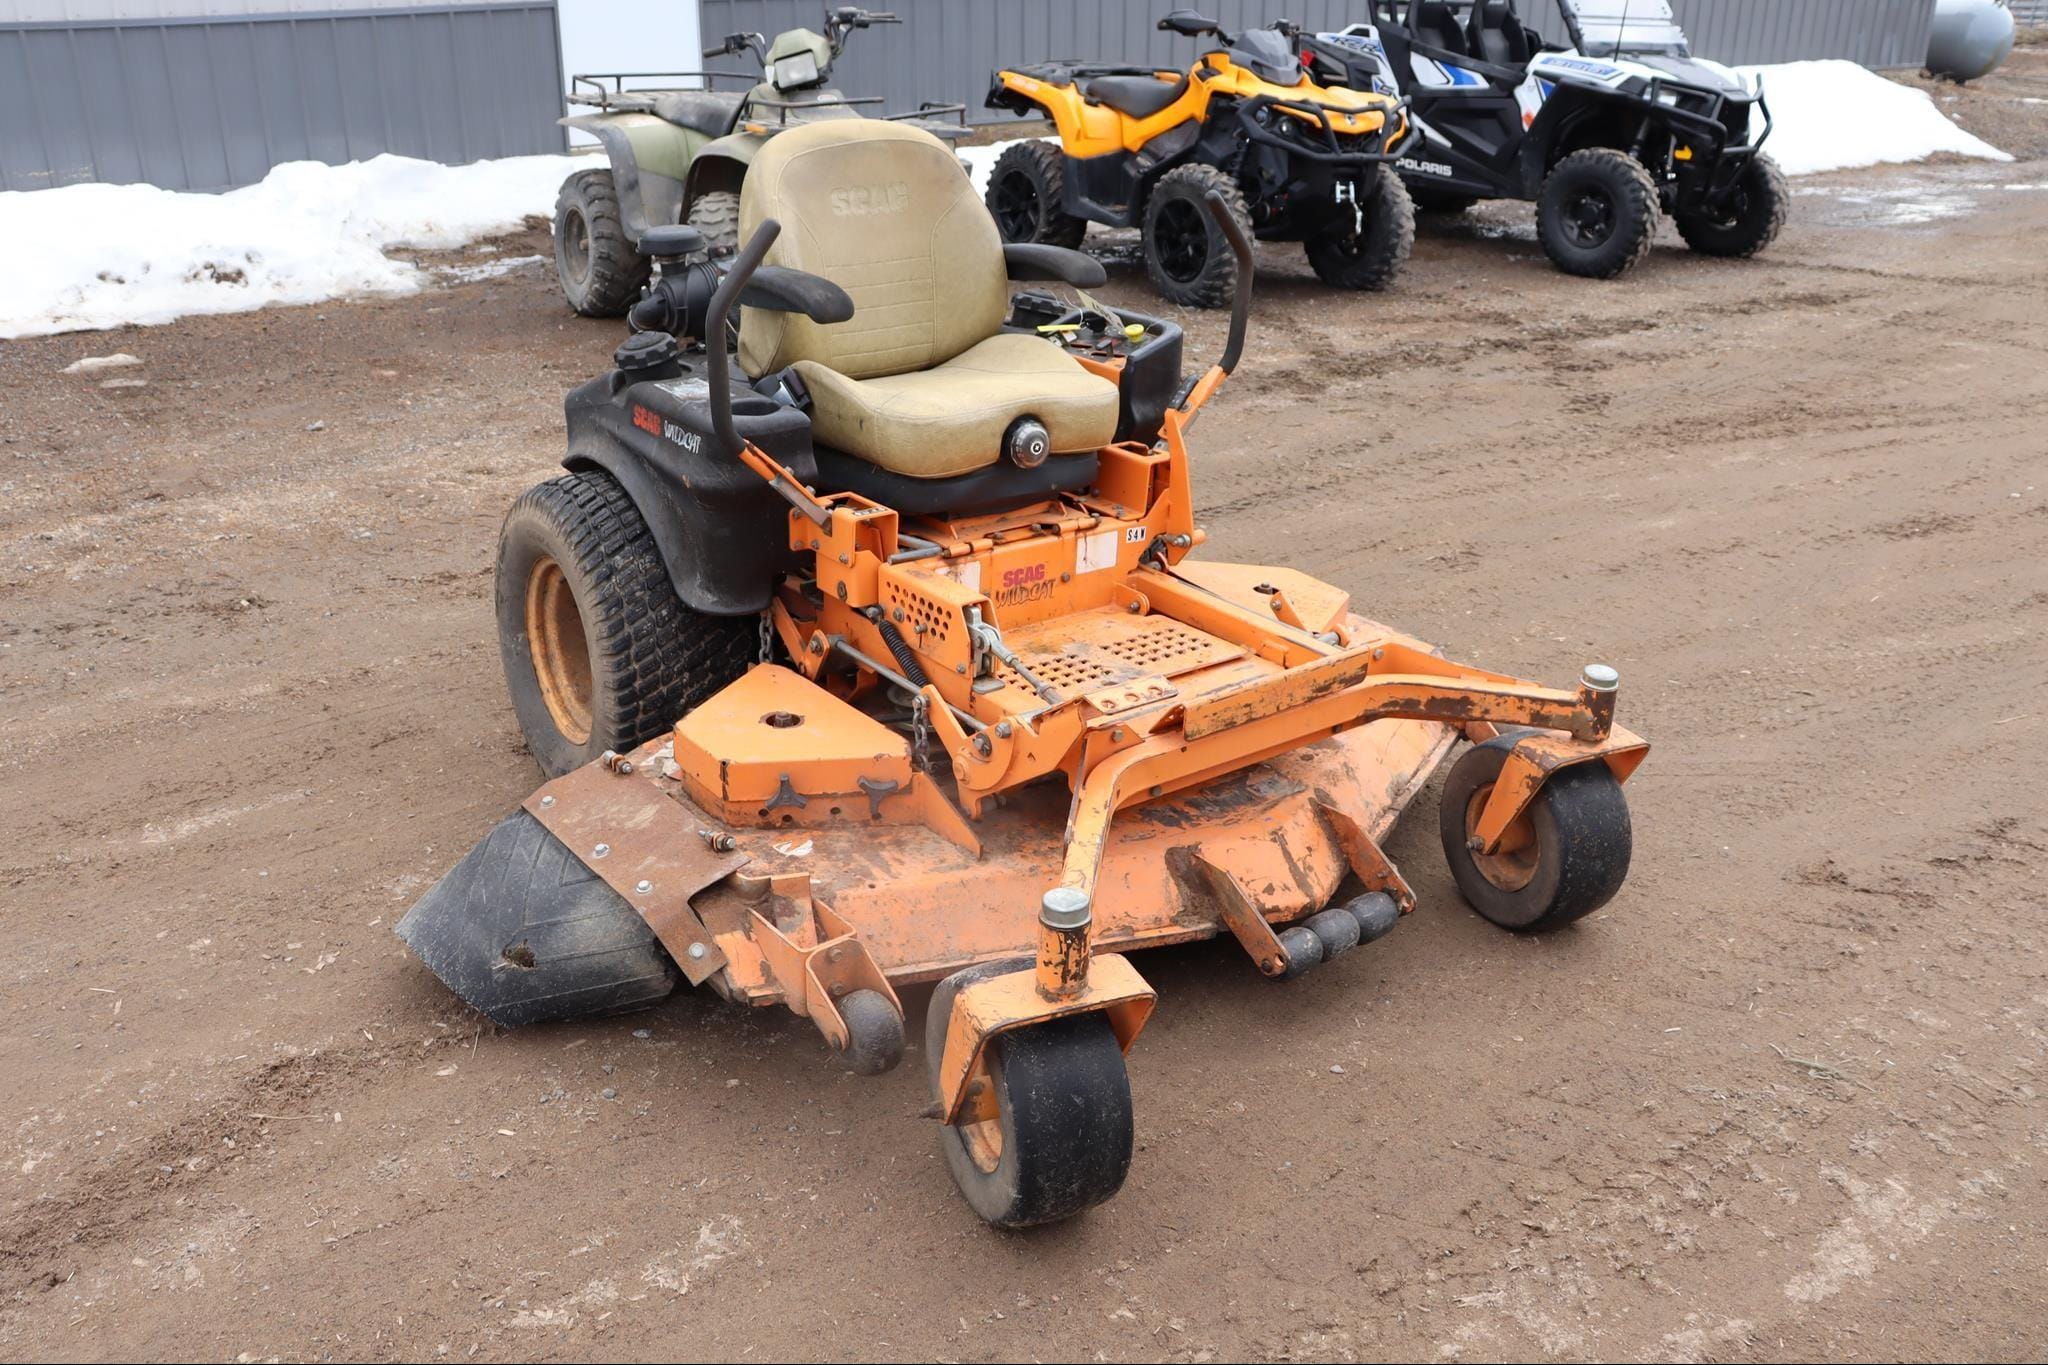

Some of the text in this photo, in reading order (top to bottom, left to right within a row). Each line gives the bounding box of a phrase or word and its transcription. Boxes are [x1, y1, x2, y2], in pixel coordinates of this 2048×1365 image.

[1395, 157, 1452, 177] POLARIS
[831, 181, 912, 216] SCAG
[633, 404, 702, 454] SCAG WILDCAT
[1003, 563, 1045, 588] SCAG
[995, 578, 1056, 608] WILDCAT
